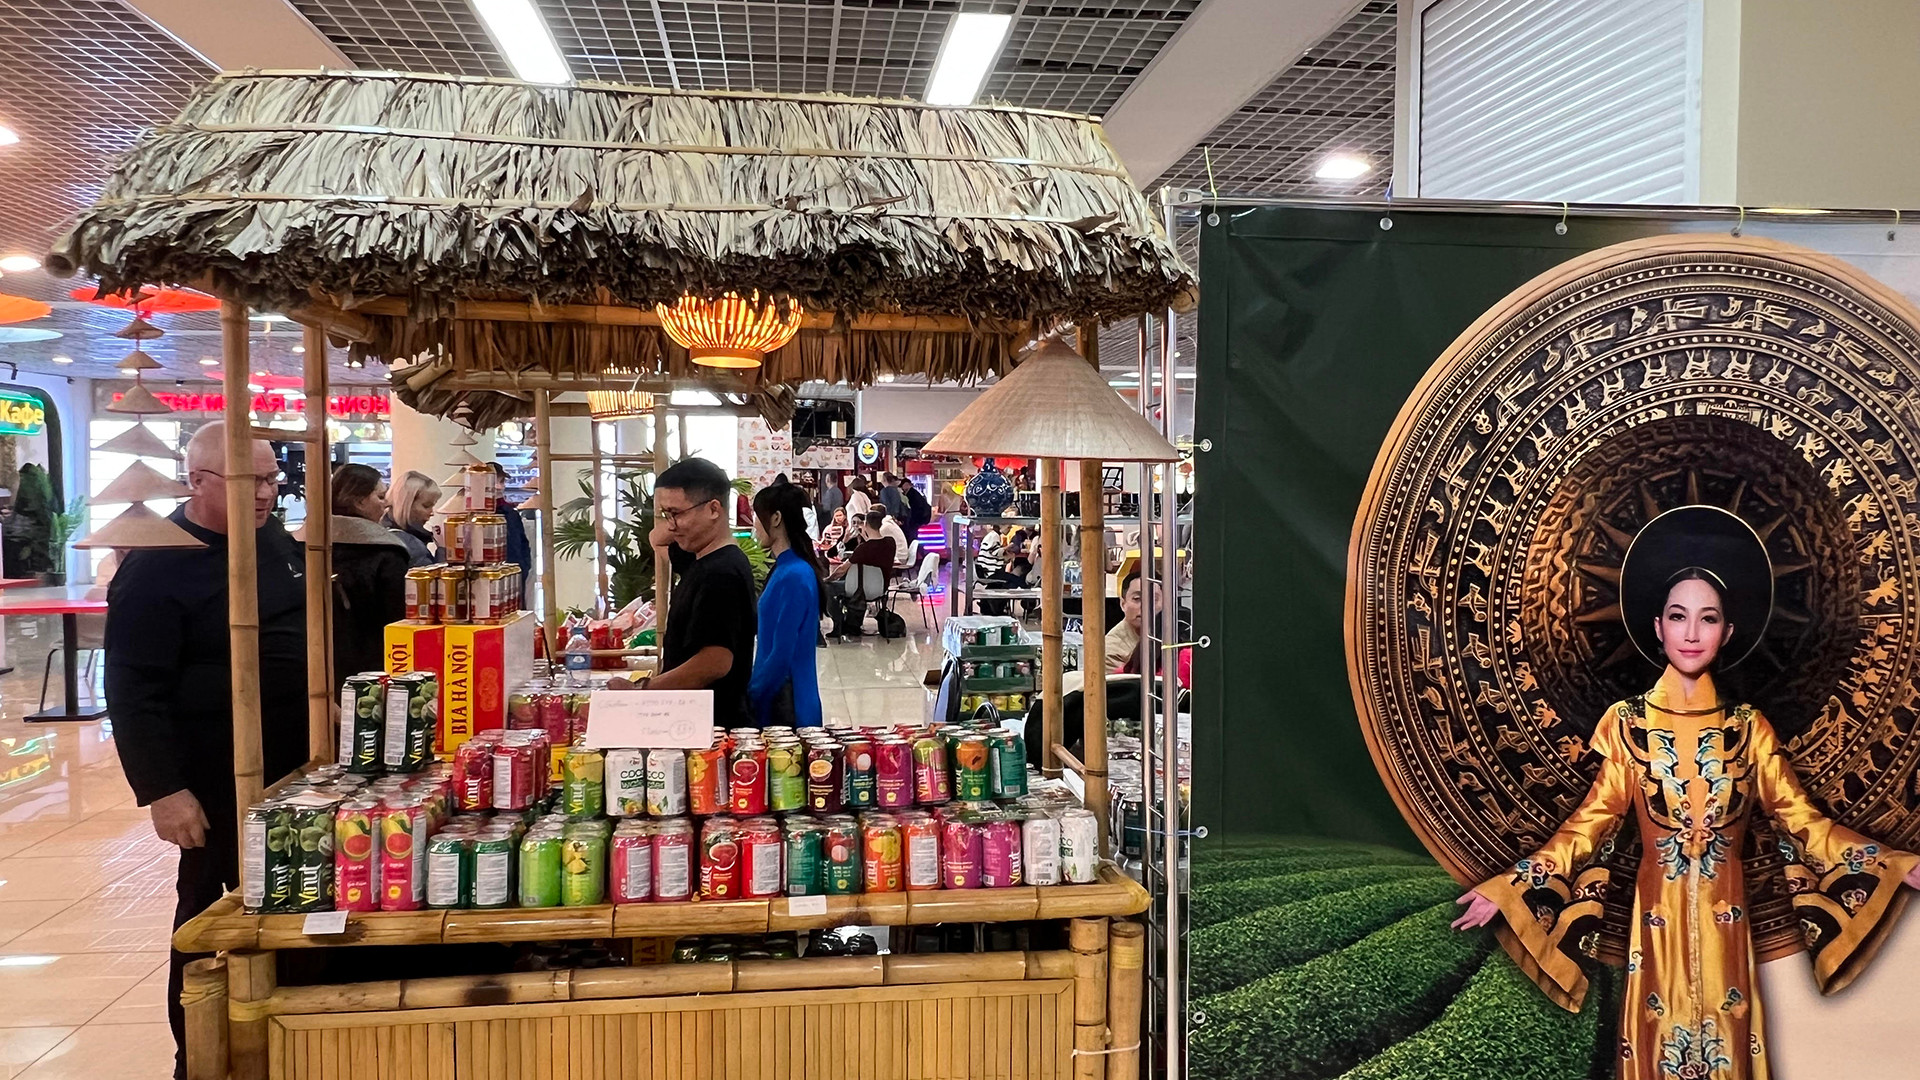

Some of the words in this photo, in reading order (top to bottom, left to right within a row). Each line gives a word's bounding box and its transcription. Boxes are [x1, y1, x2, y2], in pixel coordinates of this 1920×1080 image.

[0, 400, 45, 430] Кафе
[388, 643, 412, 674] NỘI
[447, 645, 472, 674] NỘI
[446, 678, 468, 702] HÀ
[451, 706, 468, 735] BIA
[620, 768, 644, 780] COC
[1008, 850, 1022, 886] Vinut
[299, 862, 322, 906] Vinut
